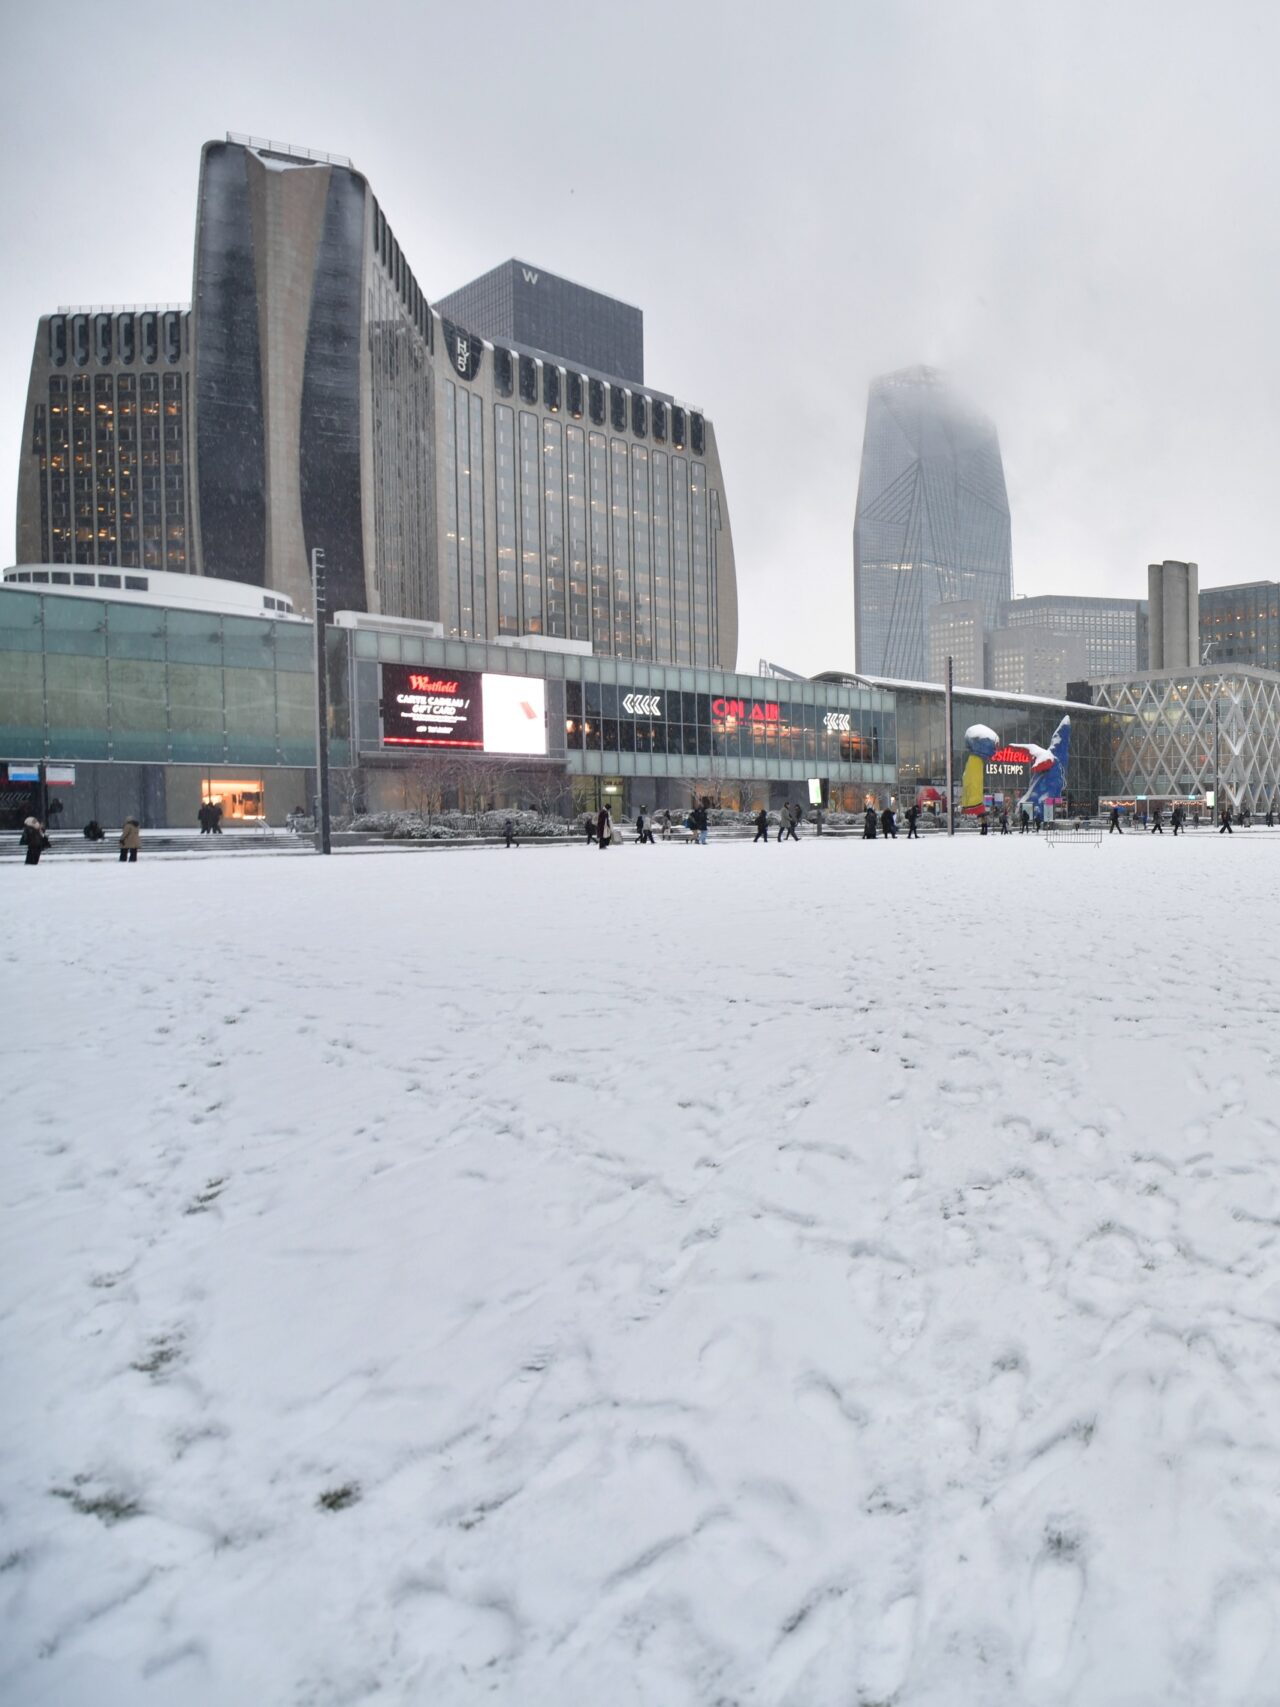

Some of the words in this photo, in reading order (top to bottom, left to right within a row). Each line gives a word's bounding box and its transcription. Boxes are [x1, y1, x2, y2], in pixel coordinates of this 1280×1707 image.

[521, 268, 538, 285] W
[409, 675, 458, 693] Westfield
[412, 704, 432, 713] GIFT
[433, 706, 456, 715] CARD
[713, 698, 744, 718] ON
[986, 764, 998, 774] LES
[1003, 764, 1024, 775] TEMPS
